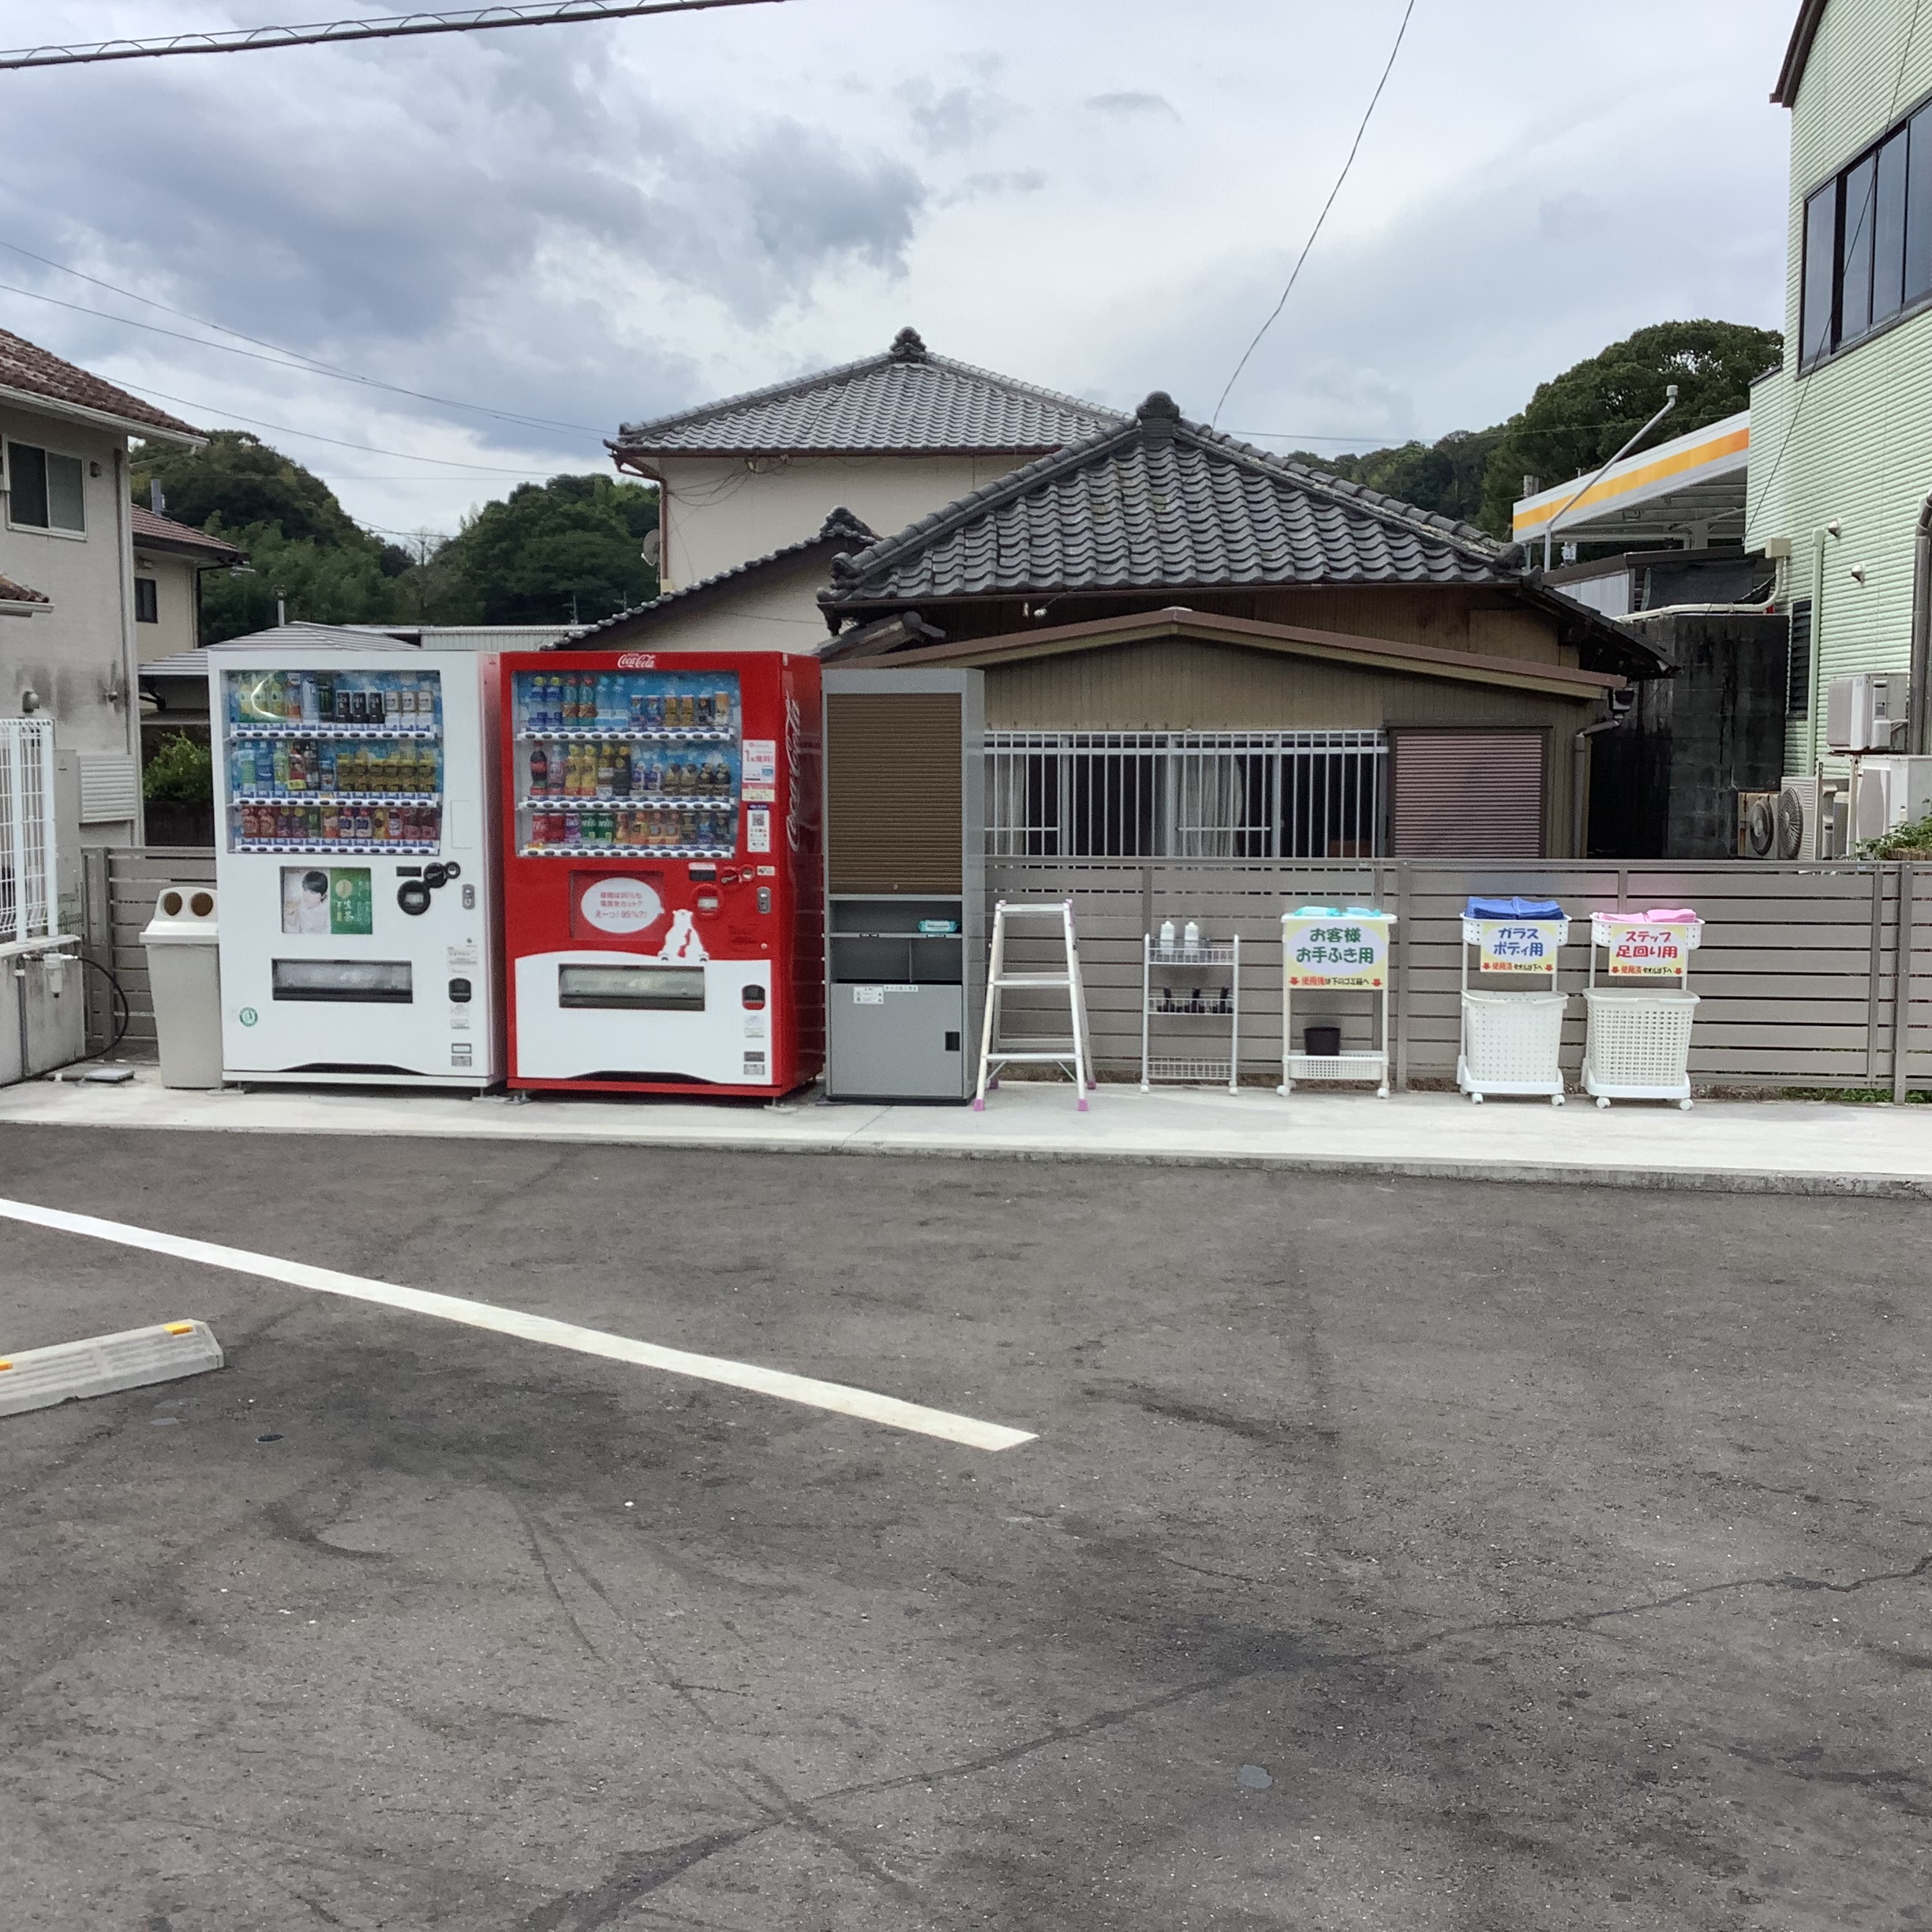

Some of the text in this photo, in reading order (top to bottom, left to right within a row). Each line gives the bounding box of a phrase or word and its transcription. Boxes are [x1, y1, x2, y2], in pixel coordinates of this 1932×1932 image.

[1309, 927, 1361, 943] お客様
[1498, 927, 1539, 939] ガラス
[1625, 930, 1672, 942] ステップ
[1295, 946, 1374, 964] お手ふき用
[1493, 941, 1544, 957] ボディ用
[1616, 945, 1678, 958] 足回り用
